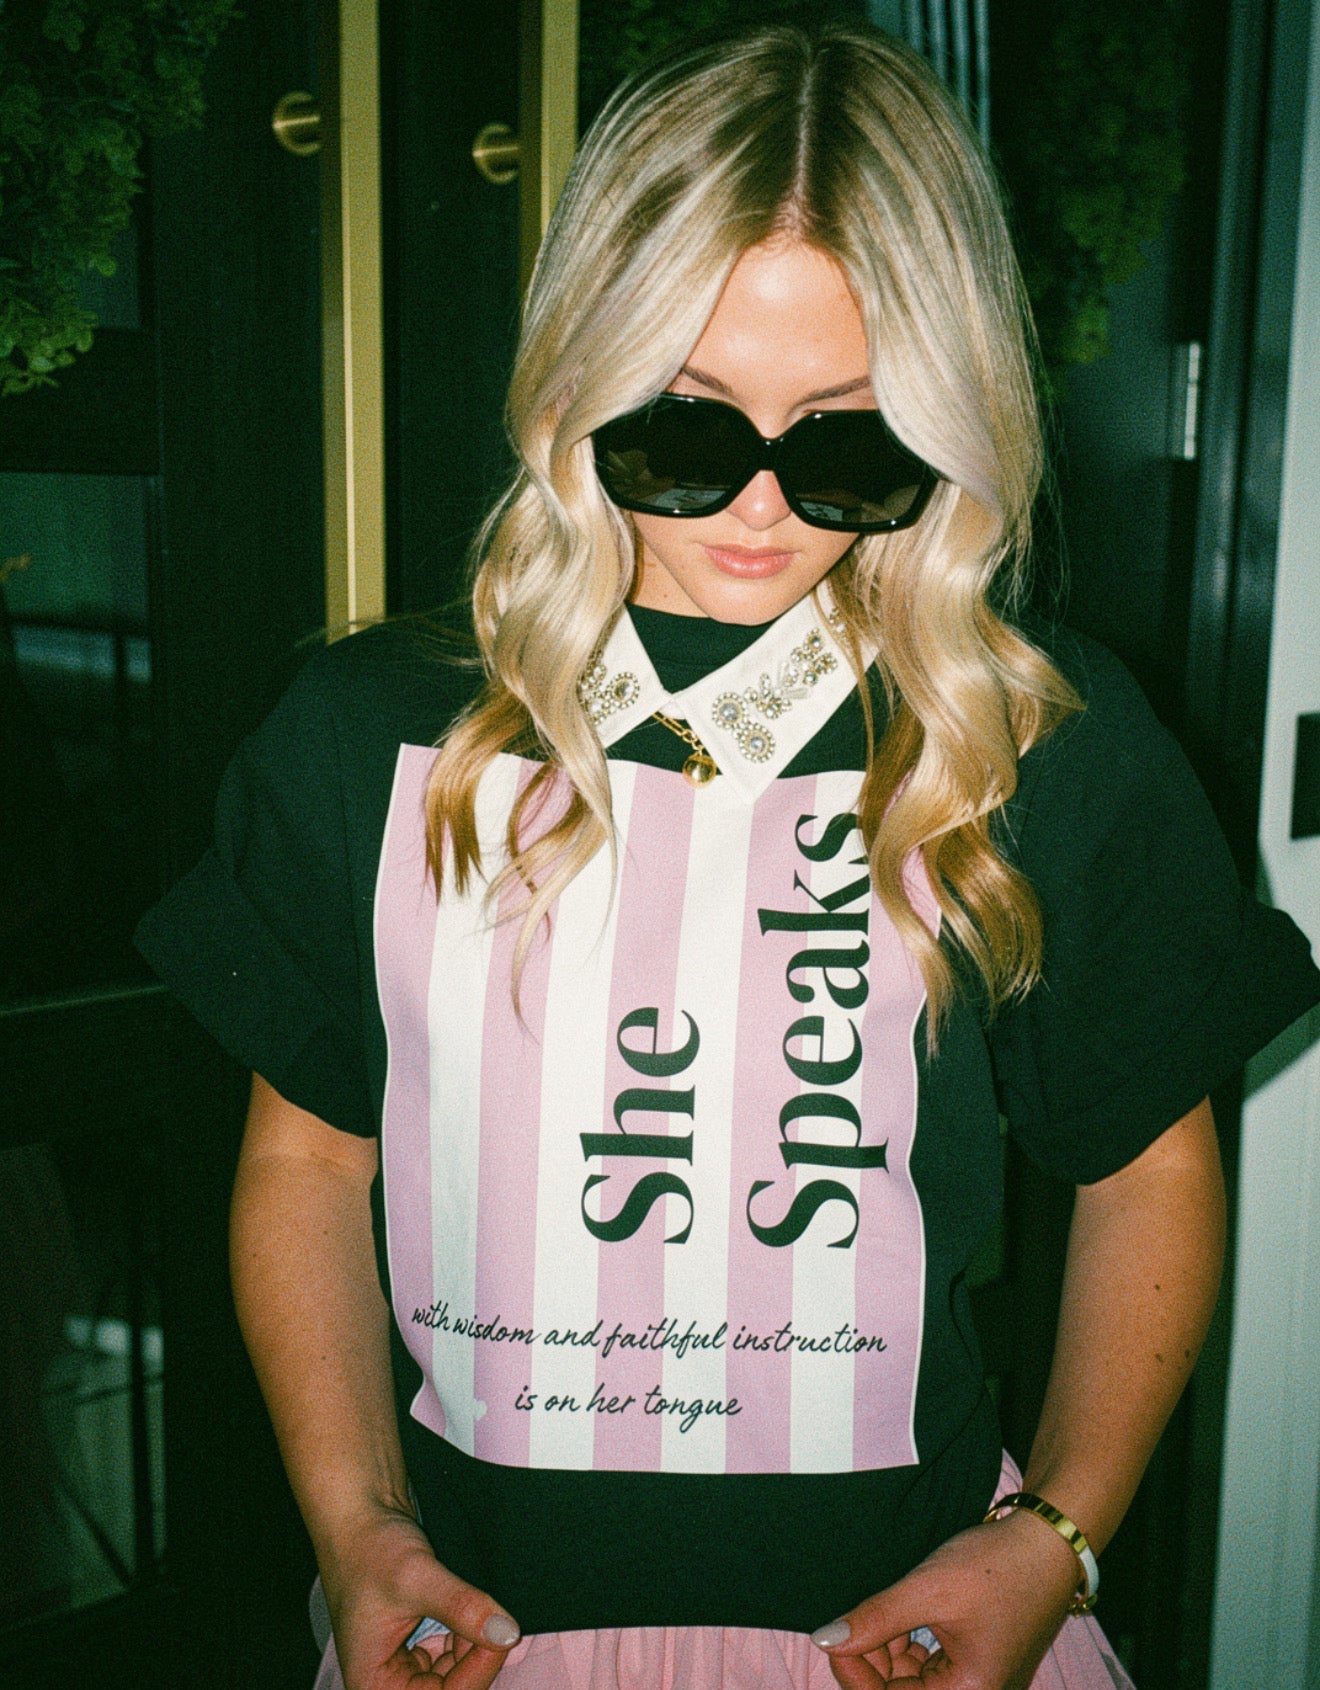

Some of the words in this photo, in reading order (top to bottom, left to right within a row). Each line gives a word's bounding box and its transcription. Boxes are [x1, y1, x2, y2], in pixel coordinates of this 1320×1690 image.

[746, 811, 889, 1249] Speaks
[579, 1006, 700, 1244] She
[411, 1299, 451, 1332] with
[452, 1313, 540, 1346] wisdom
[544, 1319, 601, 1348] and
[603, 1318, 726, 1359] faithful
[732, 1320, 887, 1353] instruction
[514, 1385, 536, 1412] is
[543, 1394, 580, 1412] on
[585, 1382, 637, 1414] her
[643, 1387, 743, 1434] tongue
